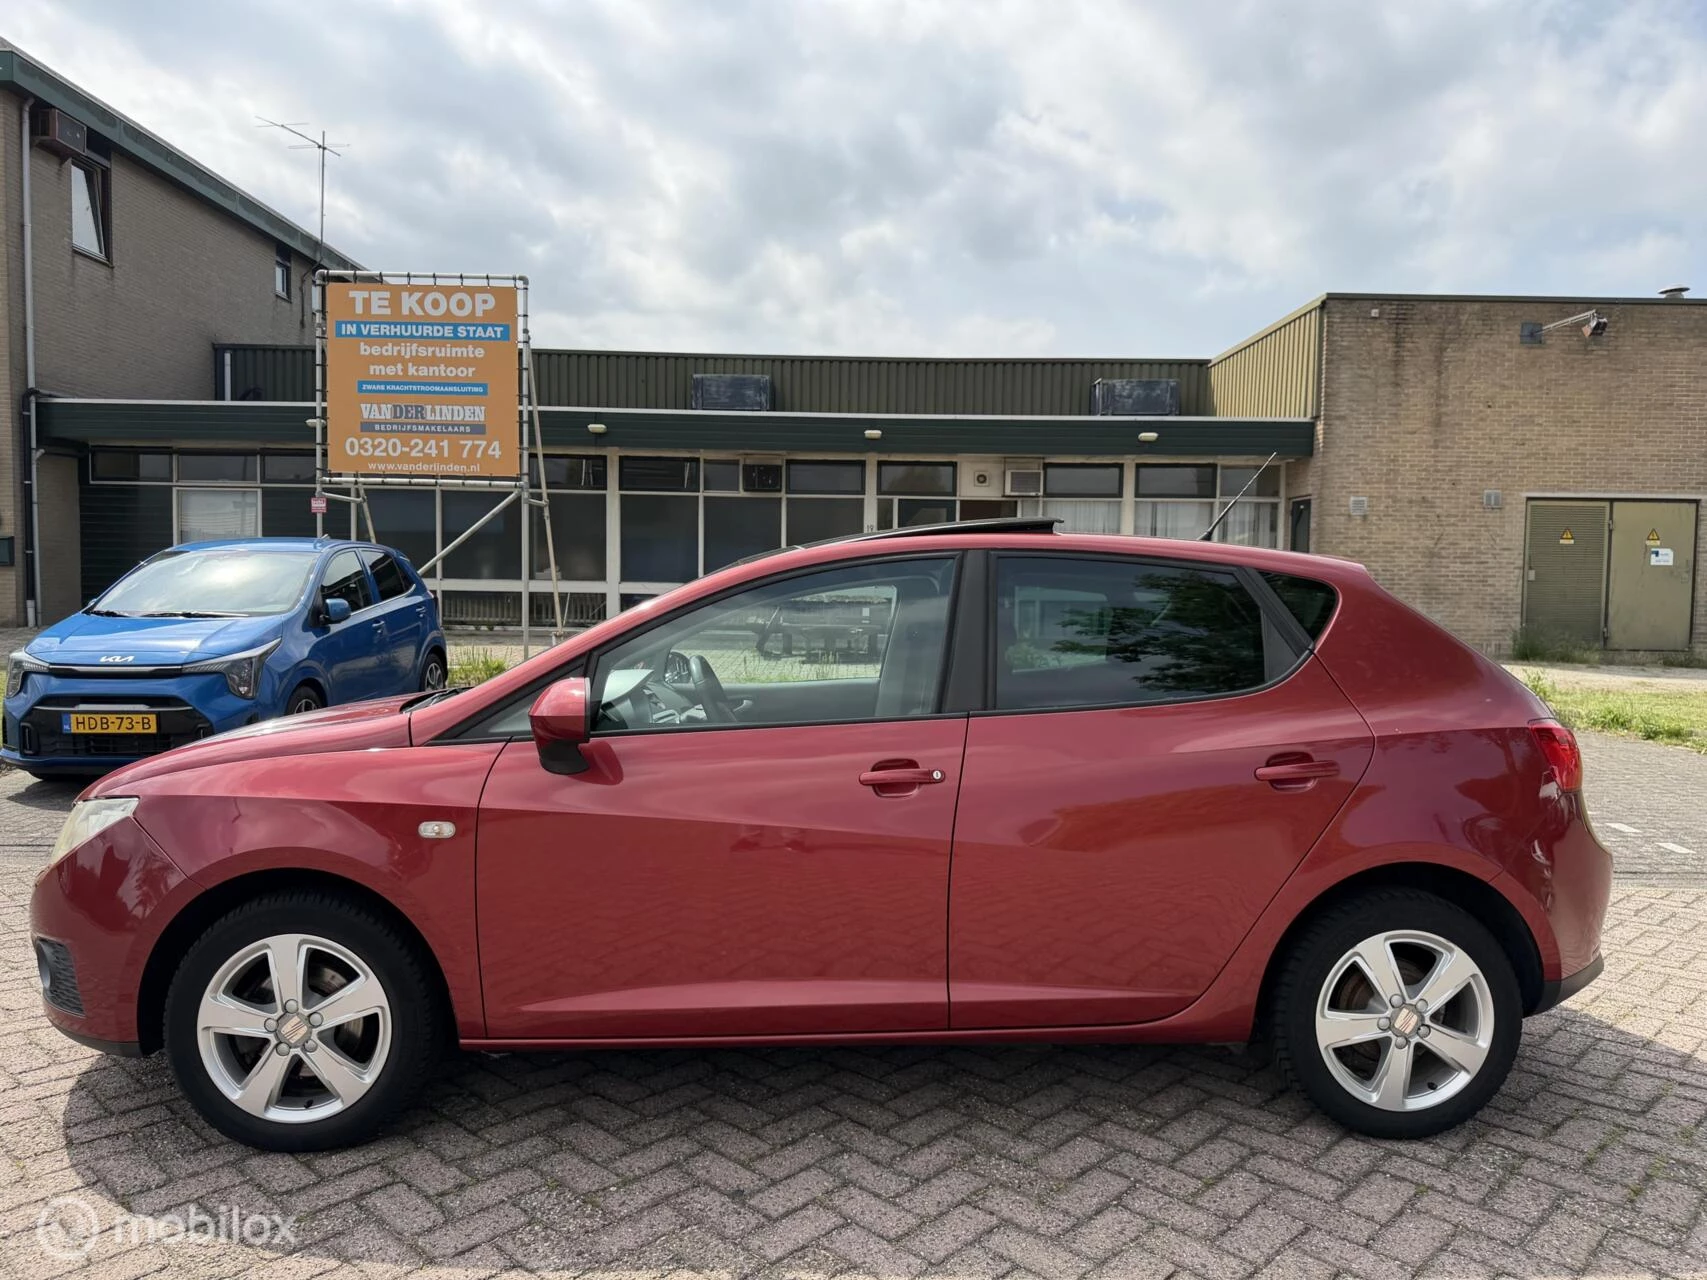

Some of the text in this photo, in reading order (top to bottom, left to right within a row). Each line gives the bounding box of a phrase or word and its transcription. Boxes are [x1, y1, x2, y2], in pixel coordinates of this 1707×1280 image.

[349, 291, 495, 317] TE KOOP
[341, 323, 503, 338] IN VERHUURDE STAAT
[359, 342, 485, 358] bedrijfsruimte
[369, 363, 475, 377] met kantoor
[386, 385, 484, 393] KRACHTSTROOMAANSLUITING
[374, 424, 471, 433] BEDRIJFSMAKELAARS
[345, 437, 501, 459] 0320-241 774
[368, 462, 480, 472] www.vanderlinden.nl
[75, 716, 152, 730] HDB-73-B
